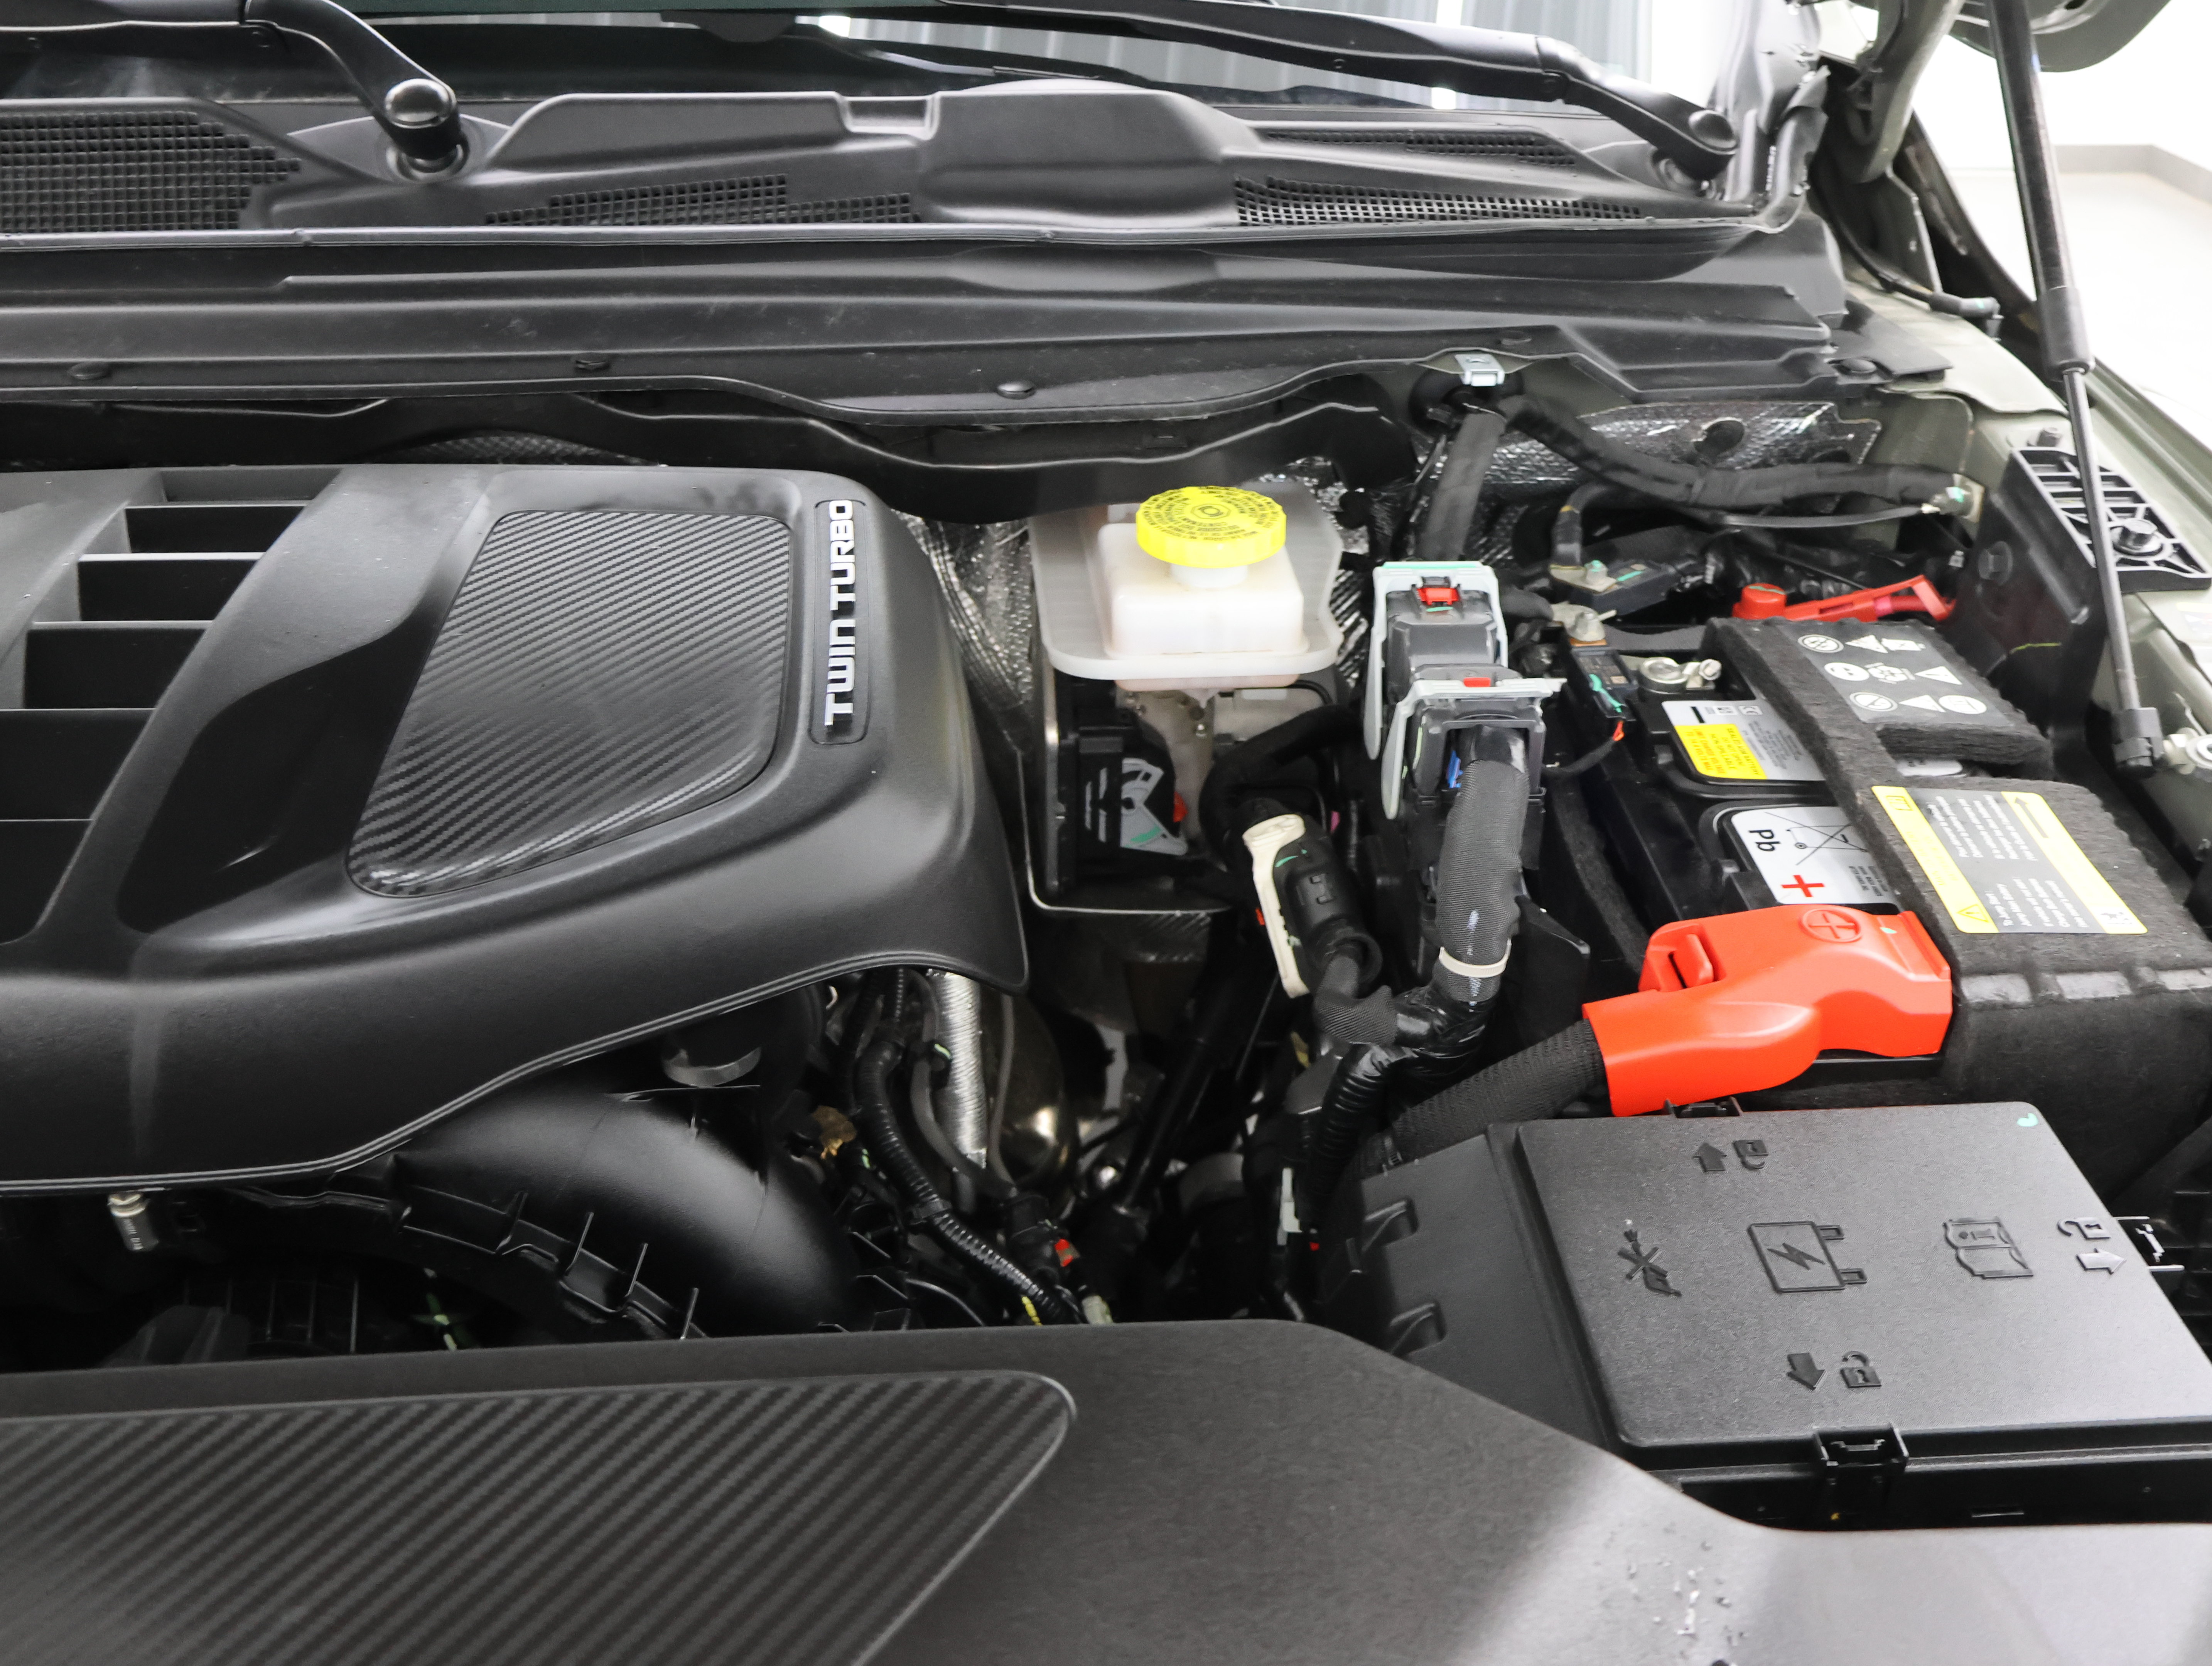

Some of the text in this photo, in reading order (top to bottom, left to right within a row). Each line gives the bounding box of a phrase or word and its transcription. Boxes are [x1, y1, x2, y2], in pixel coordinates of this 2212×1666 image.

[824, 500, 856, 725] TWIN TURBO
[1744, 756, 1759, 774] BATTERY
[1749, 829, 1780, 852] Pb
